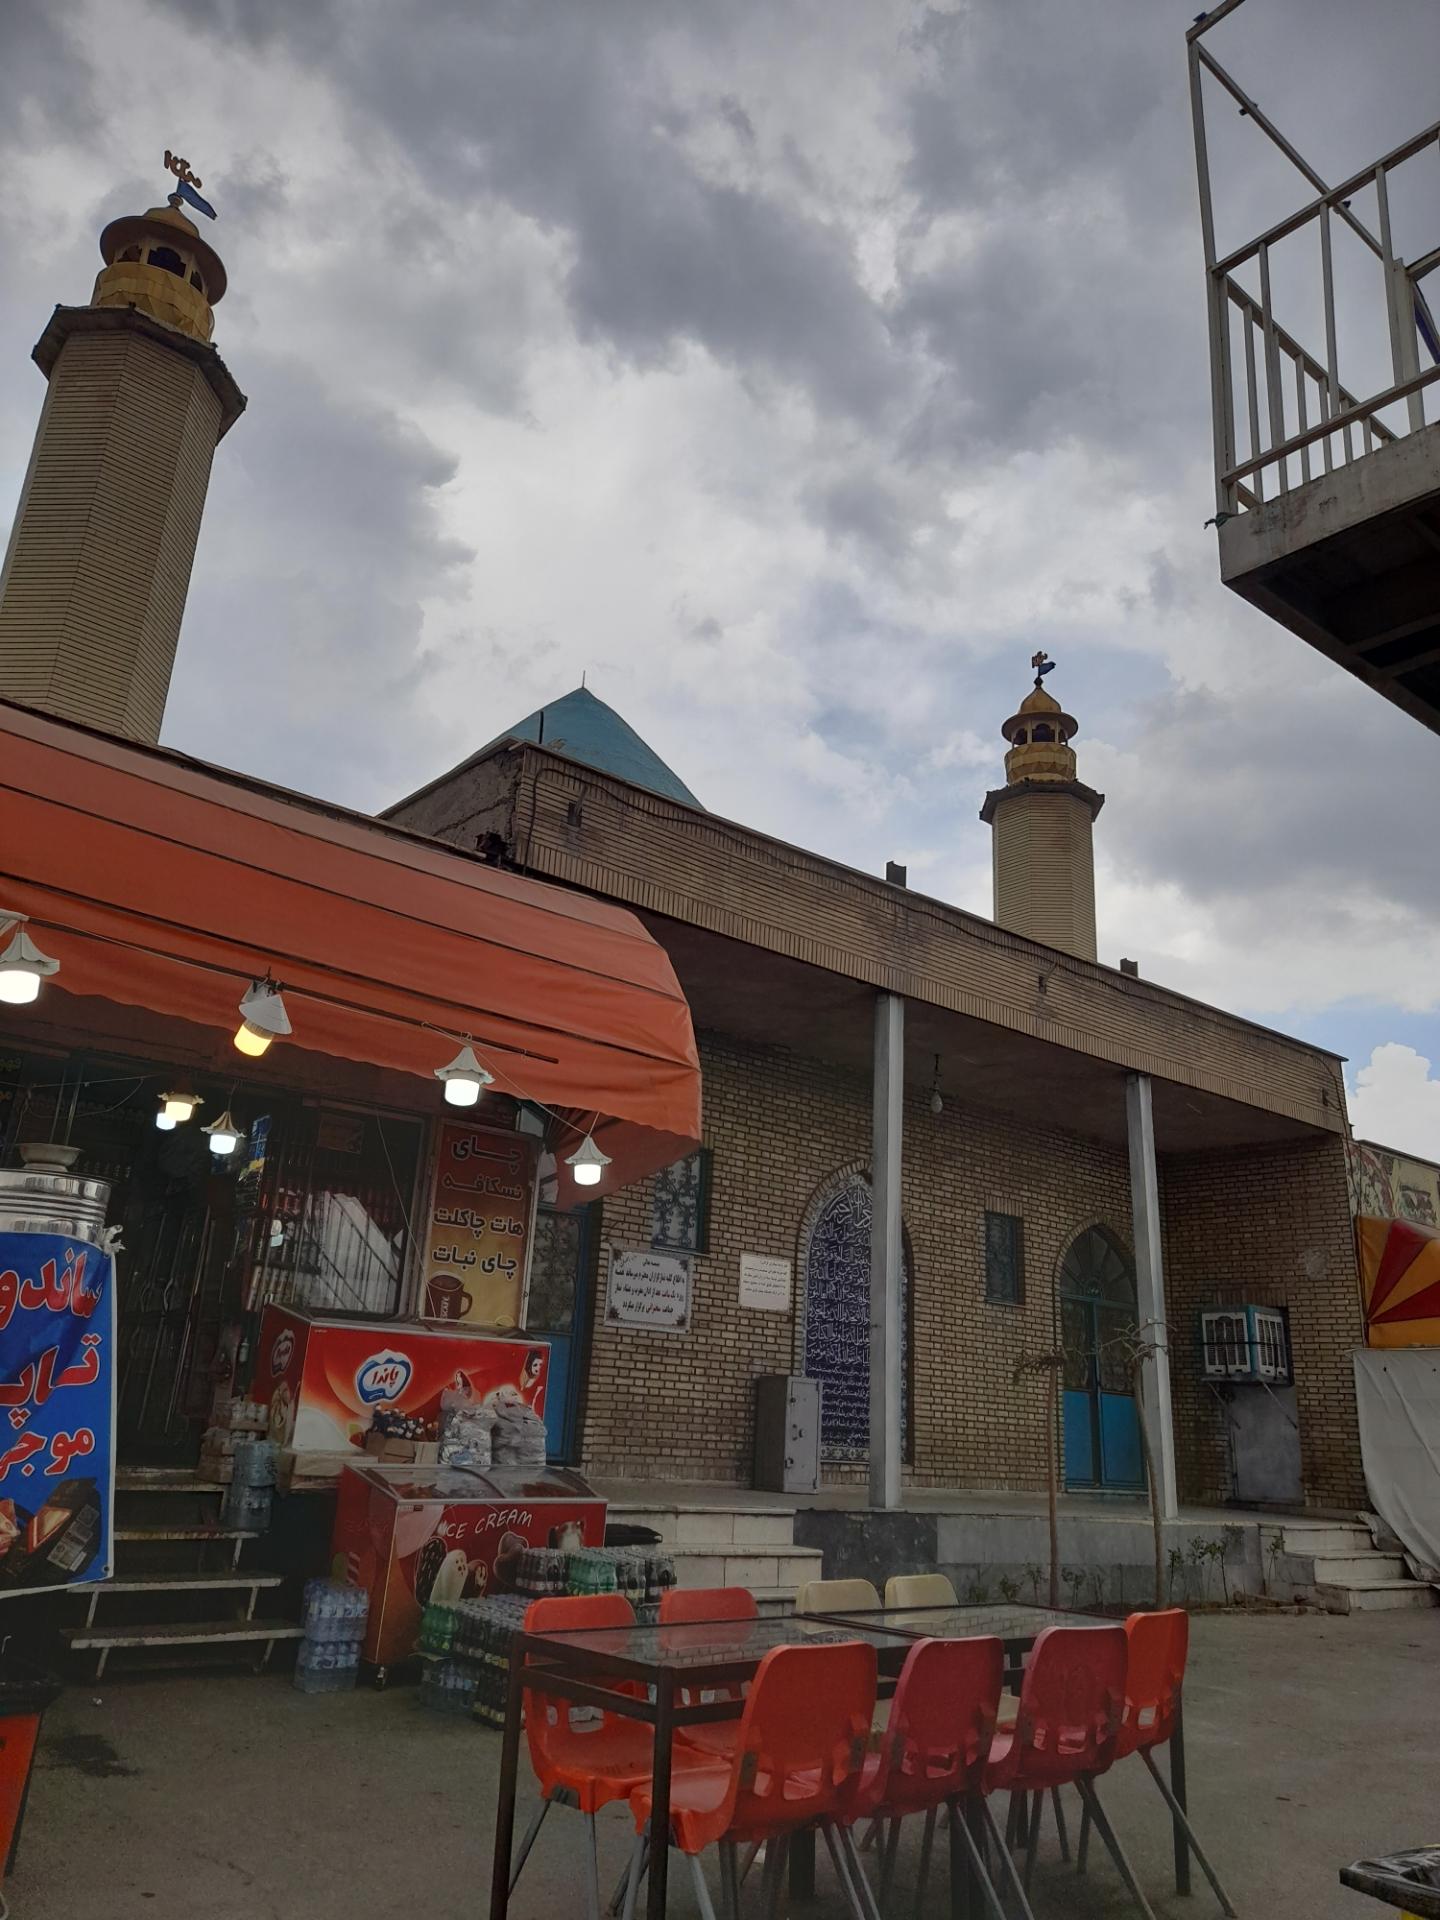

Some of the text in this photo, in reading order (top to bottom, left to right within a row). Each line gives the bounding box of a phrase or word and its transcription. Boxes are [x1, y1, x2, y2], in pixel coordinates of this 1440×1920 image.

[452, 1136, 521, 1173] چای
[442, 1171, 523, 1200] نسکافه
[434, 1208, 525, 1238] هات چاکلت
[432, 1245, 519, 1280] چای نبات
[371, 1366, 400, 1388] پاندا
[474, 1509, 533, 1534] CREAM
